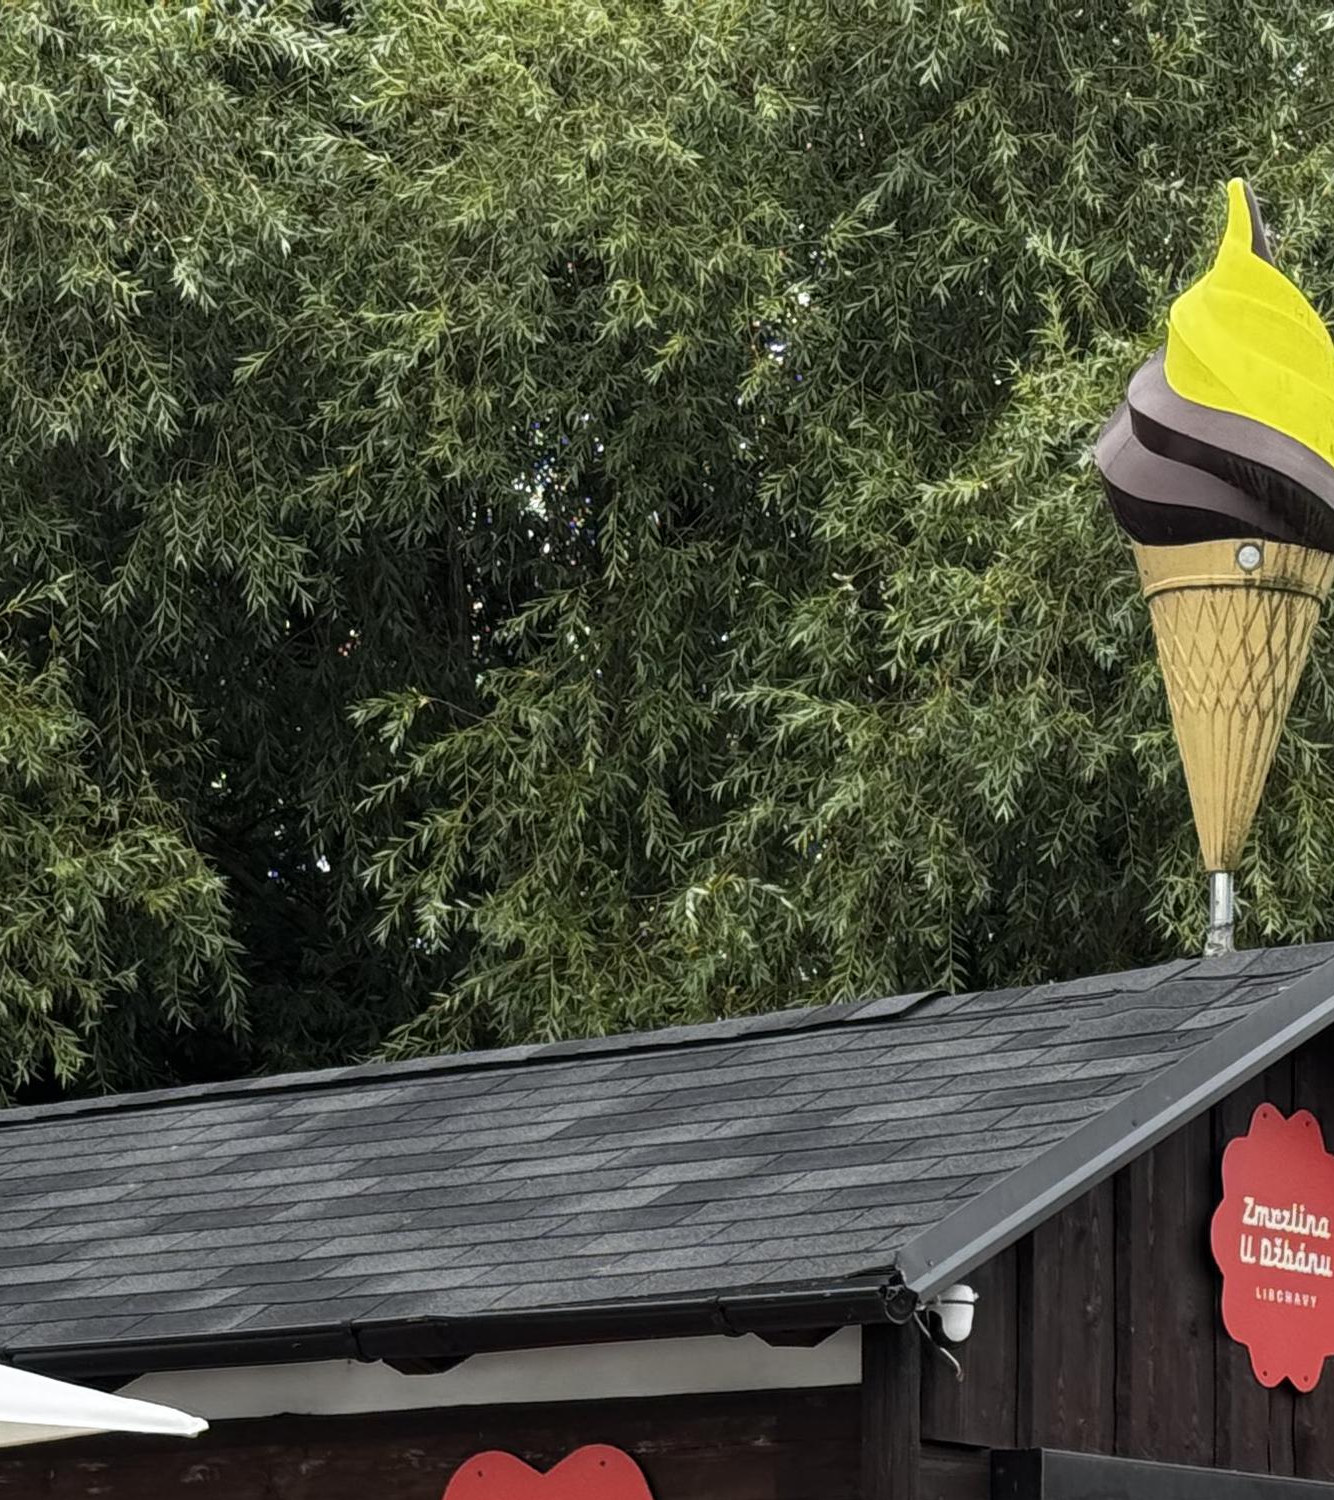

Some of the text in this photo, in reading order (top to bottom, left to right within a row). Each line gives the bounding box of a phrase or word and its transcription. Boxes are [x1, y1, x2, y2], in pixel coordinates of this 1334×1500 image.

[1242, 1196, 1331, 1239] Zmrzlina
[1240, 1233, 1334, 1277] U Džbánu
[1255, 1286, 1317, 1308] LIBCHAVY
